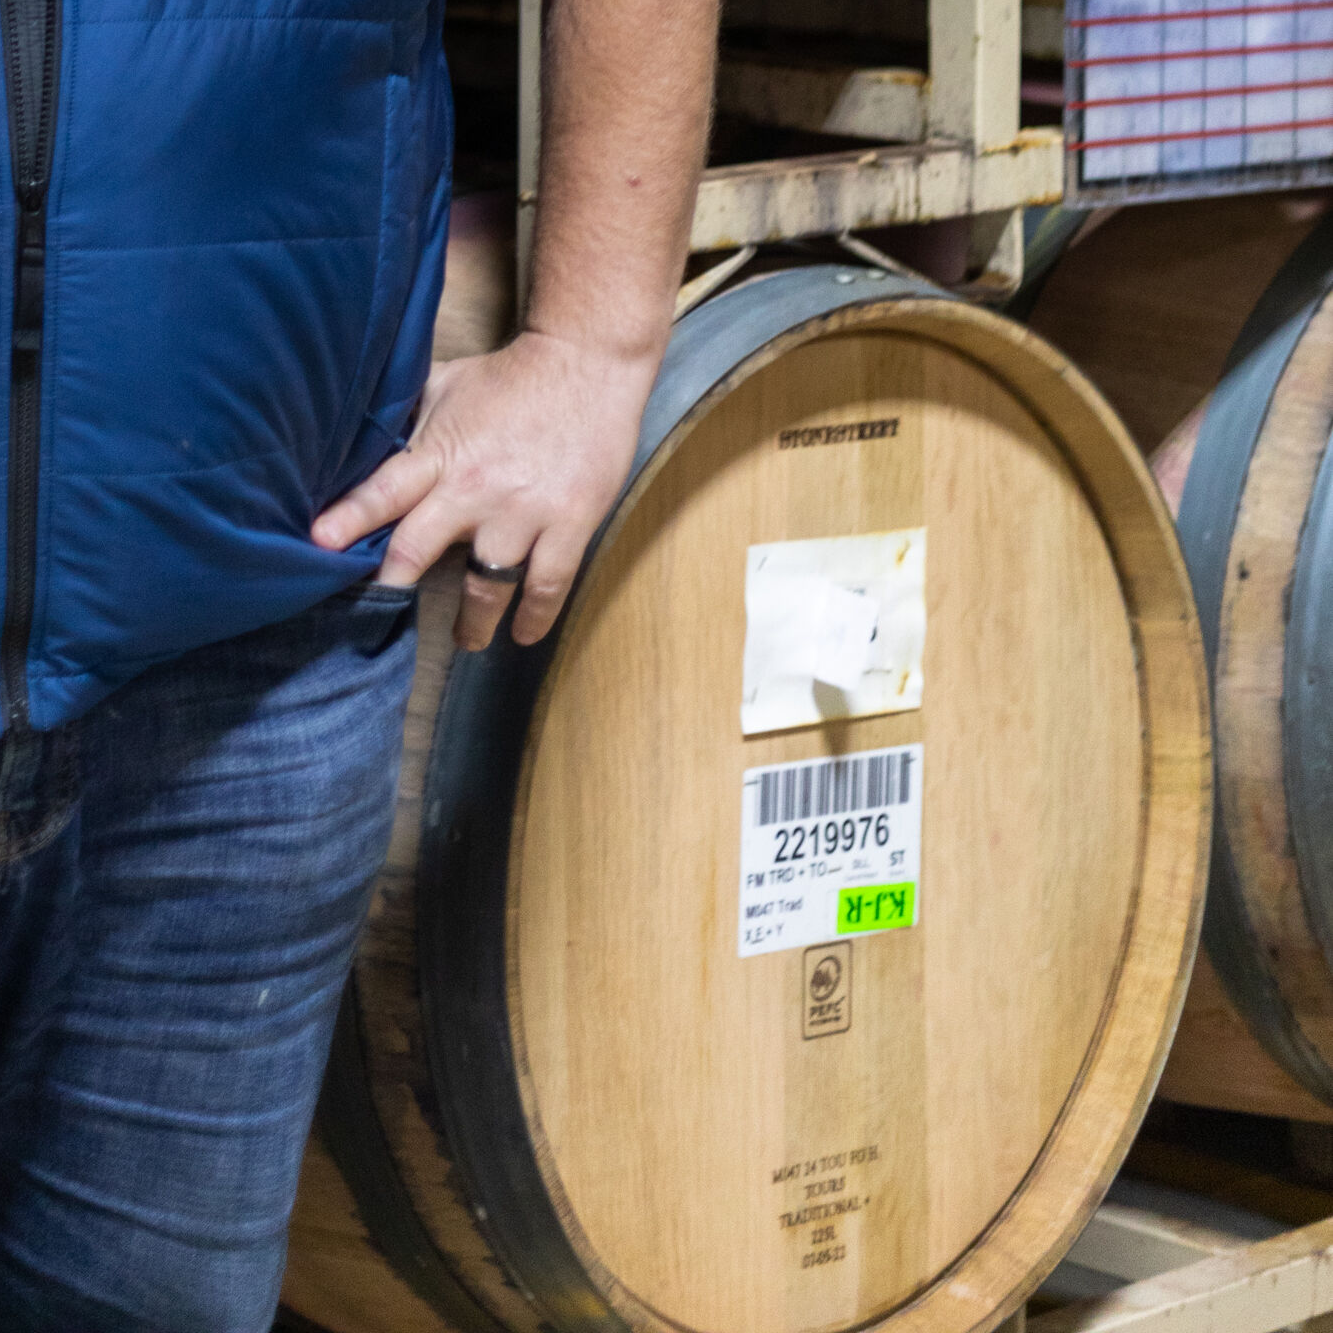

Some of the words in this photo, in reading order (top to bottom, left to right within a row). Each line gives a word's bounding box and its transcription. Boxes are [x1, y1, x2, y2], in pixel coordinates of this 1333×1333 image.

[773, 812, 890, 864] 2219976
[746, 872, 766, 890] FM
[888, 849, 906, 867] ST
[778, 1195, 863, 1231] TRADITIONAL
